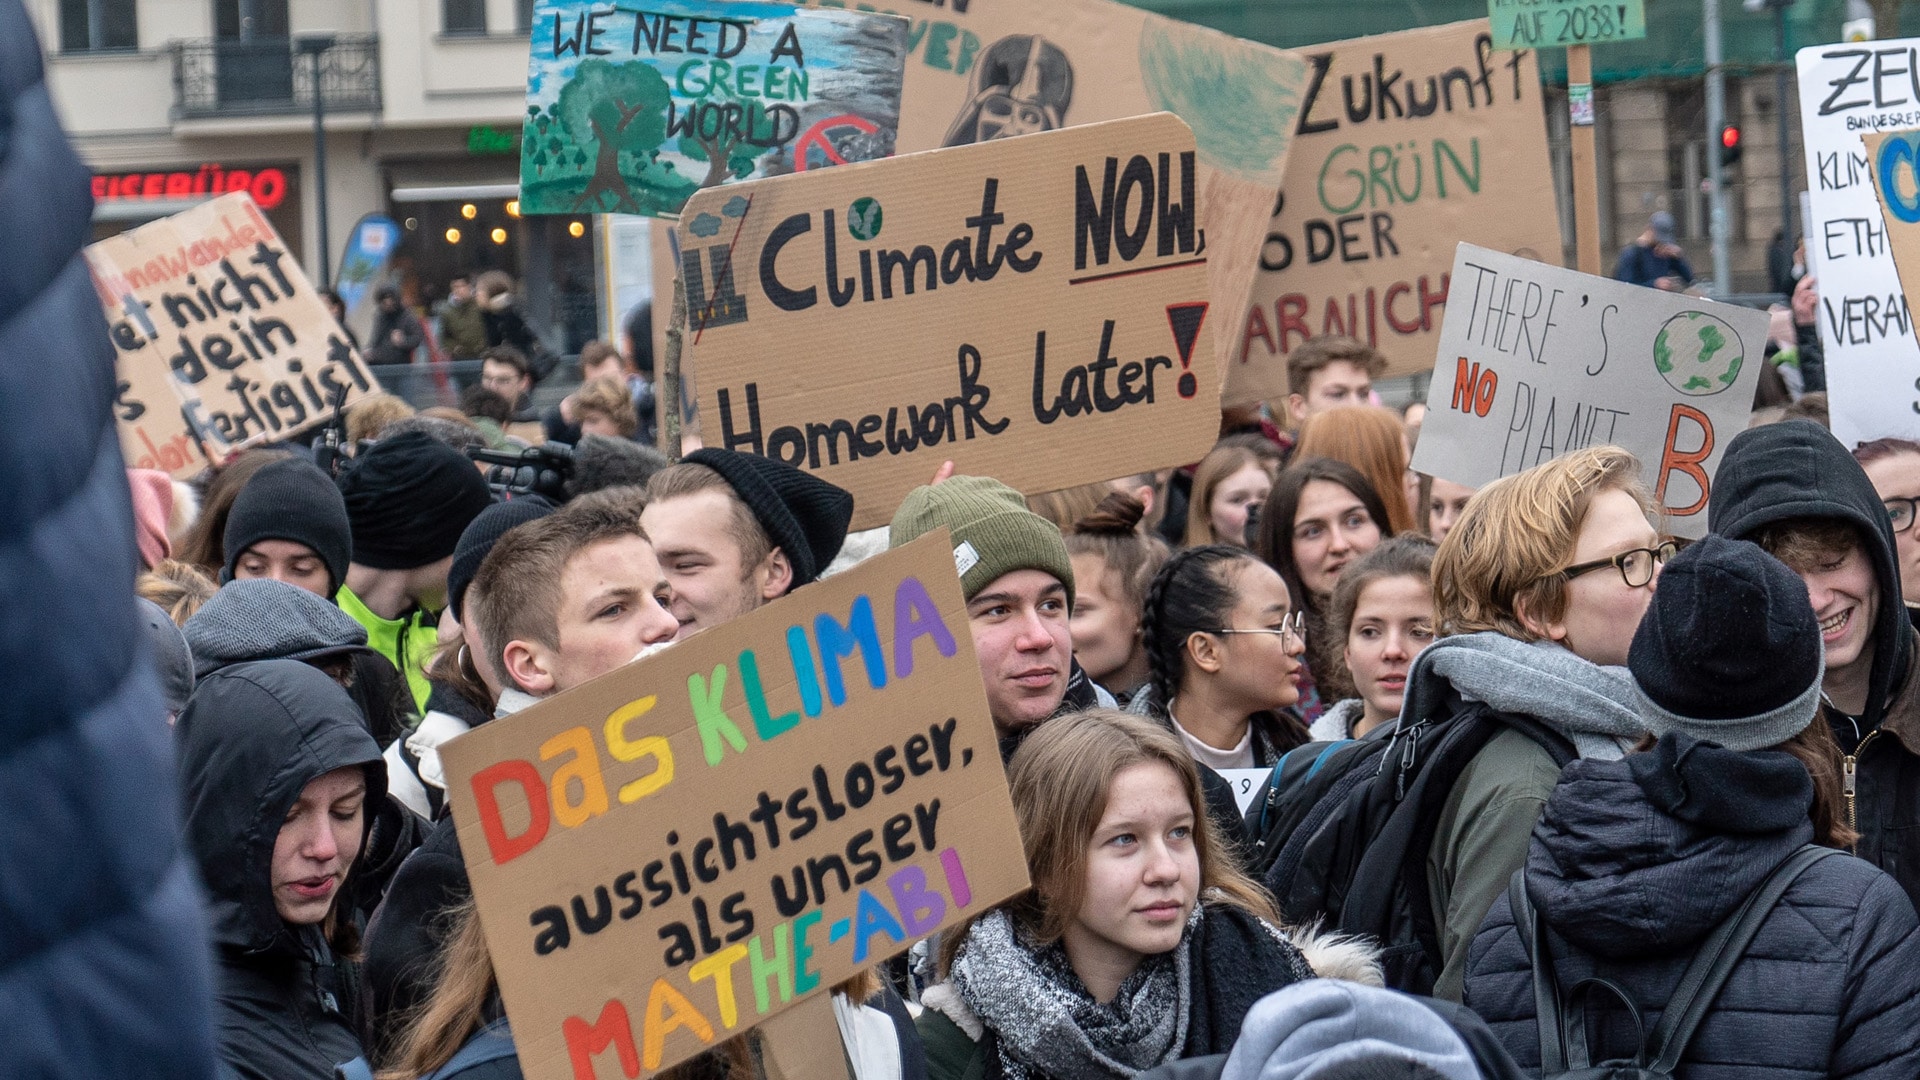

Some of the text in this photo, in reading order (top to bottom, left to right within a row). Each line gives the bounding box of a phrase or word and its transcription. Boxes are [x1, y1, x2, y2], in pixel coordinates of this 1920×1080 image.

[553, 10, 803, 68] WE NEED A
[1509, 4, 1626, 44] AUF 2038!
[667, 102, 799, 147] WORLD
[676, 59, 809, 101] GREEN
[1296, 32, 1528, 136] Zukunft
[1317, 136, 1481, 214] GRÜN
[759, 151, 1206, 311] Climate NOW,
[1259, 211, 1399, 272] ODER
[162, 241, 295, 329] nicht
[169, 316, 297, 385] dein
[717, 343, 1010, 469] Homework
[1452, 357, 1497, 418] NO
[1656, 403, 1714, 516] B
[687, 576, 957, 767] KLIMA
[530, 717, 973, 957] aussichtsloser,
[657, 798, 941, 968] als unser
[562, 847, 972, 1080] MATHE-ABI
